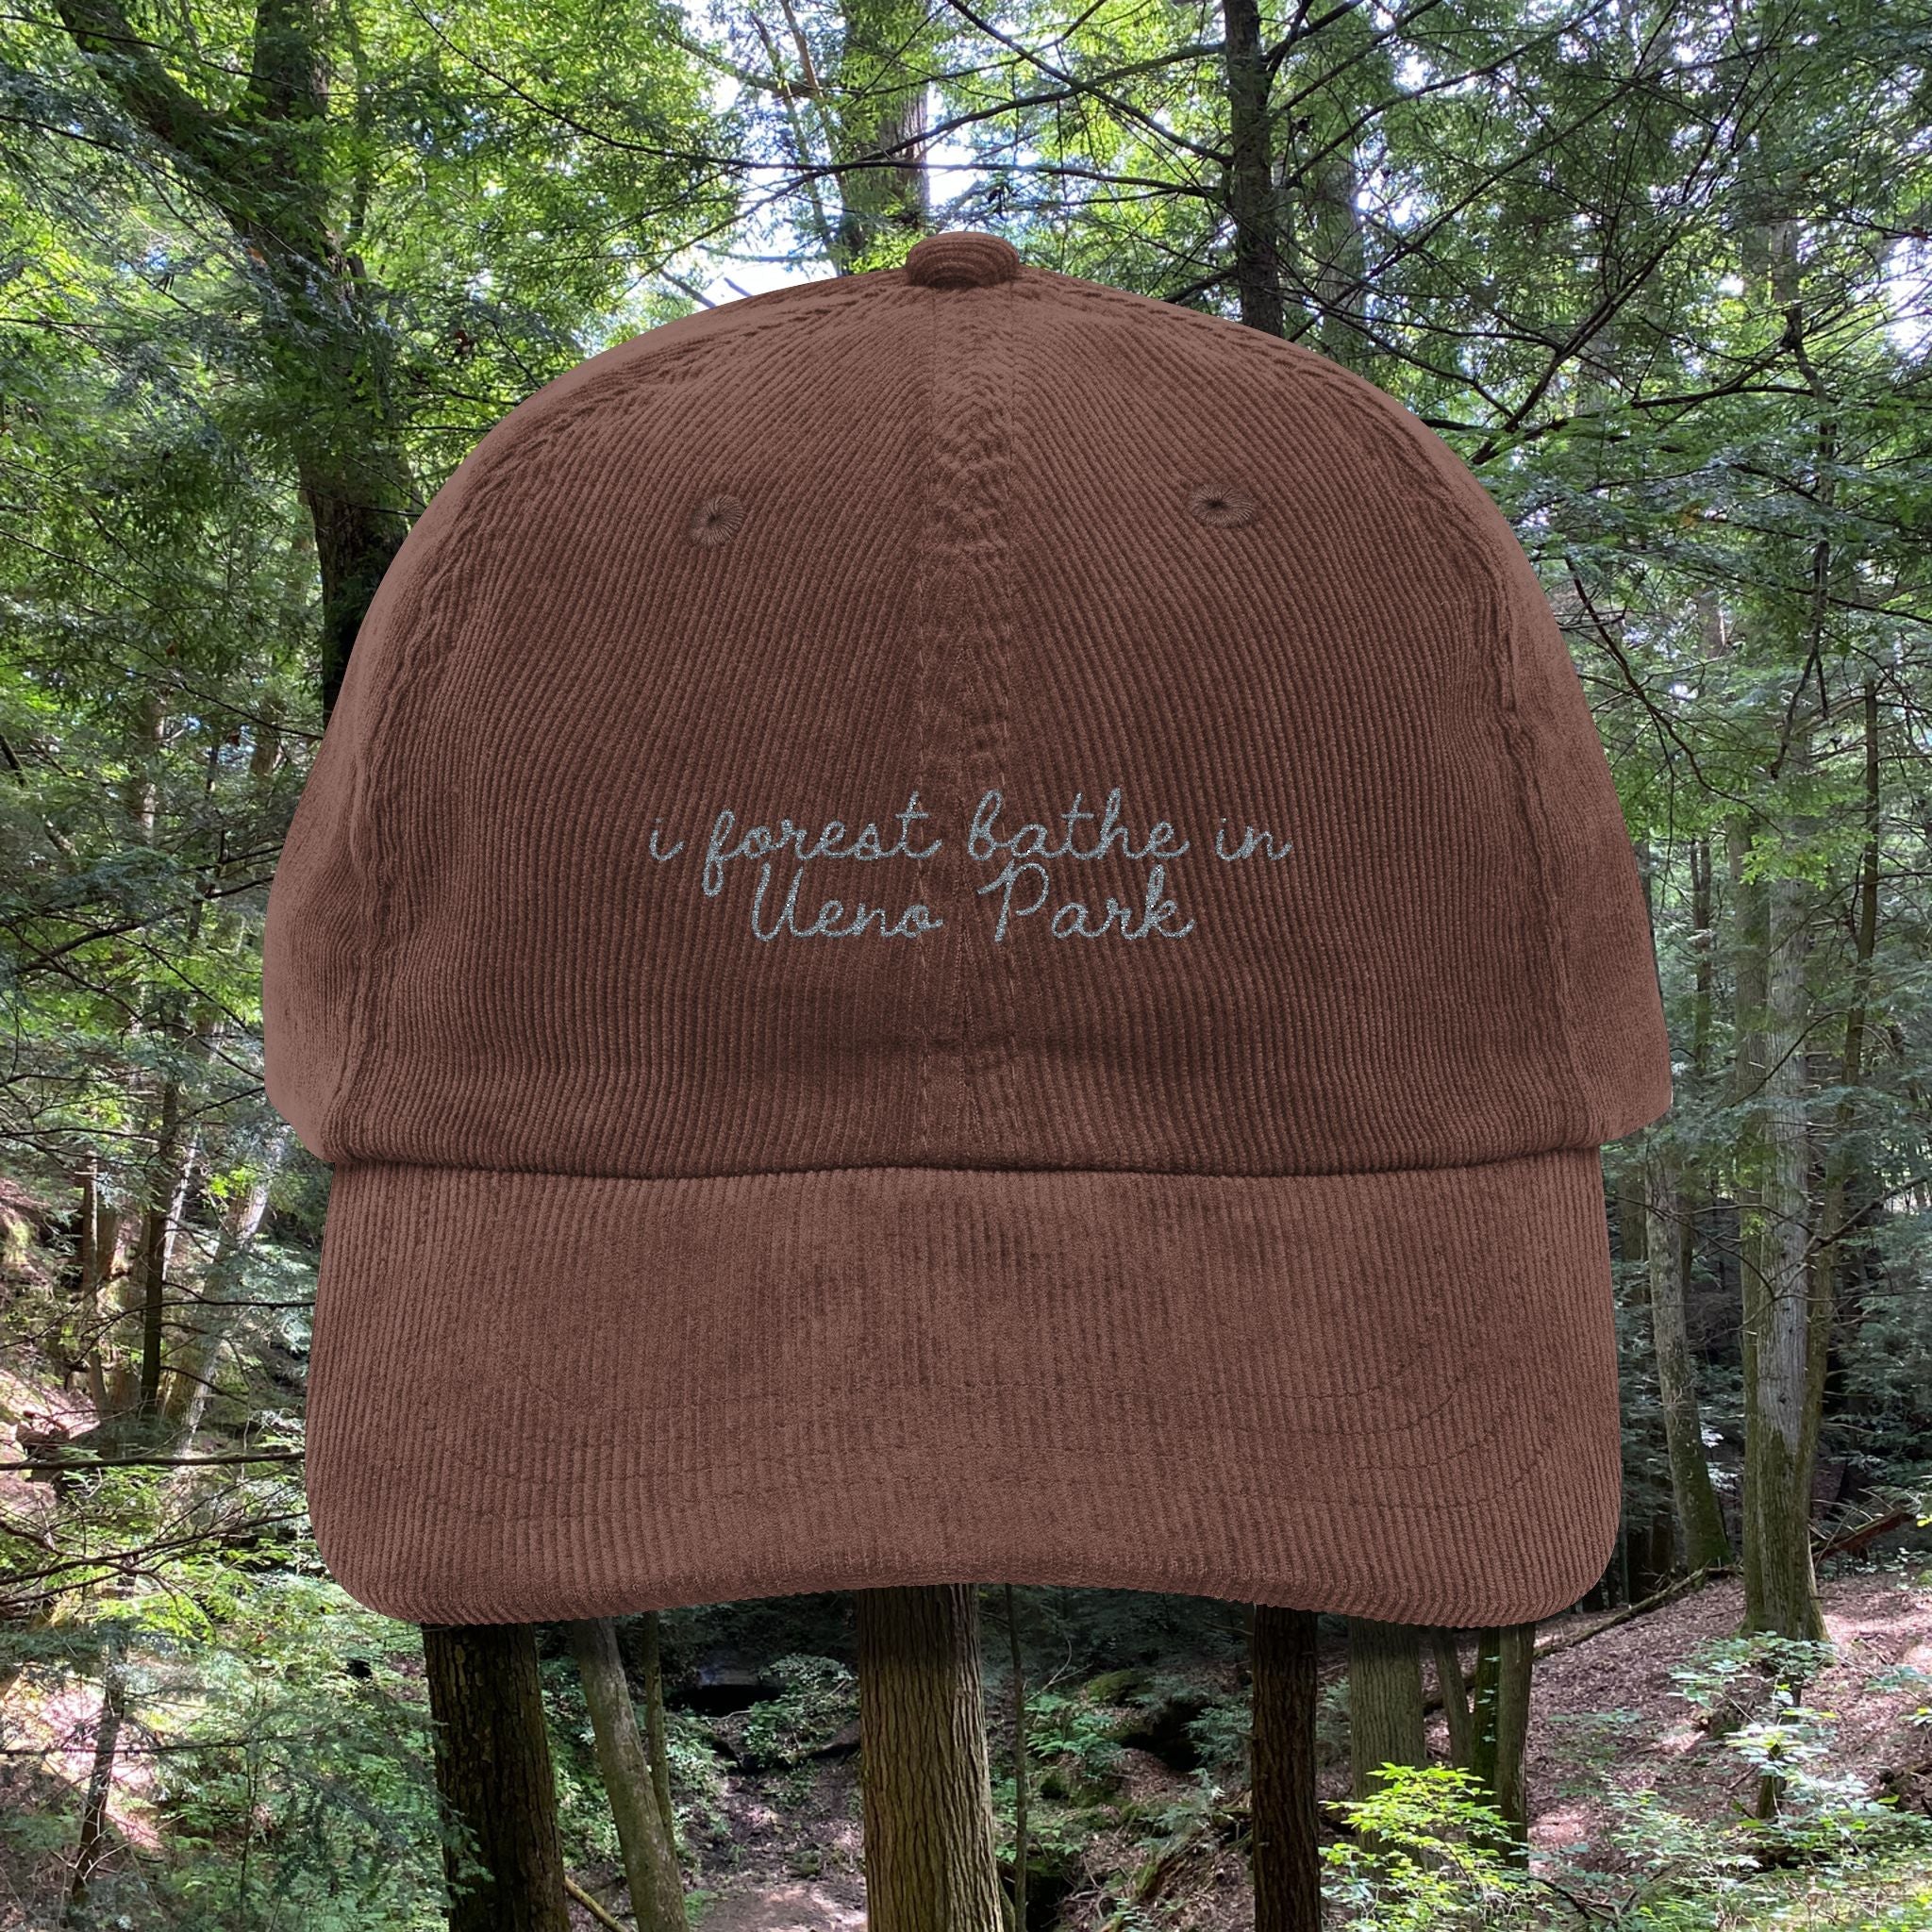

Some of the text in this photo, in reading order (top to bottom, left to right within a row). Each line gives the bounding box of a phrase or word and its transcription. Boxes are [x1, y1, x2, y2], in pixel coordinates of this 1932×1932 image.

[648, 789, 1292, 896] i forest bathe in
[752, 861, 1194, 941] Ueno Park
